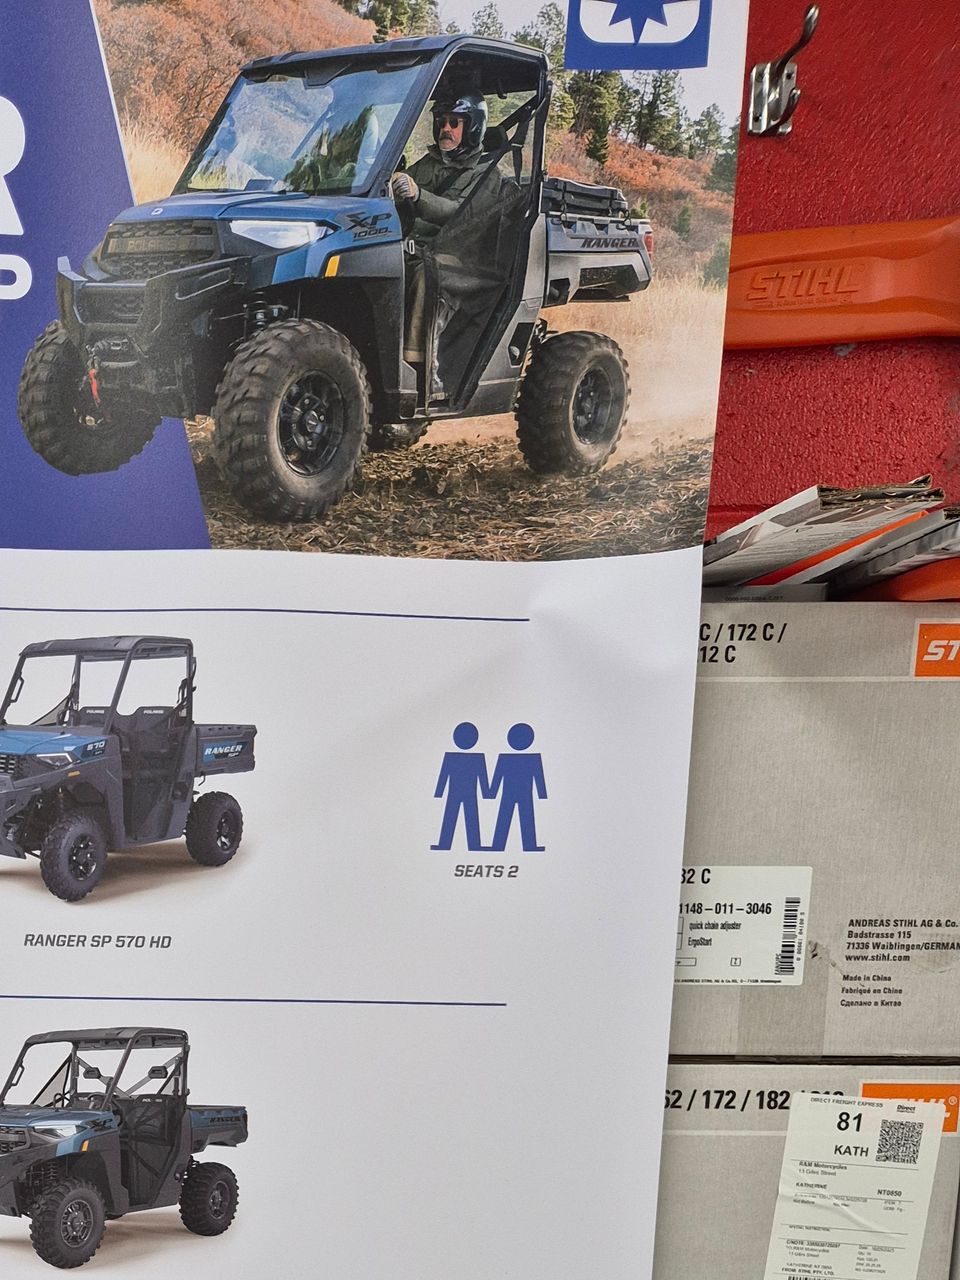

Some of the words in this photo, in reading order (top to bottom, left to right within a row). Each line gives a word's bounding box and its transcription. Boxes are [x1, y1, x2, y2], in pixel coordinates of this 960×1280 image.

[580, 236, 640, 249] RANGER
[745, 265, 859, 301] STIHL
[699, 622, 711, 642] C
[728, 623, 757, 642] 172
[762, 622, 774, 642] C
[724, 645, 736, 663] C
[922, 640, 960, 662] ST
[86, 740, 106, 751] 570
[204, 744, 243, 756] RANGER
[454, 864, 505, 878] SEATS
[507, 866, 519, 878] 2
[848, 919, 892, 928] ANDREAS
[893, 919, 918, 928] STIHL
[920, 919, 933, 928] AG
[935, 919, 943, 928] &
[944, 919, 959, 928] Co.
[23, 933, 87, 948] RANGER
[90, 934, 112, 948] SP
[114, 935, 146, 948] 570
[149, 936, 172, 949] HD
[848, 930, 895, 939] Badstrasse
[846, 942, 870, 950] 71336
[845, 953, 911, 961] www.stihl.com
[702, 1090, 736, 1110] 172
[756, 1090, 790, 1110] 182
[836, 1111, 863, 1132] 81
[834, 1144, 870, 1158] KATH
[877, 1189, 902, 1198] NT0850
